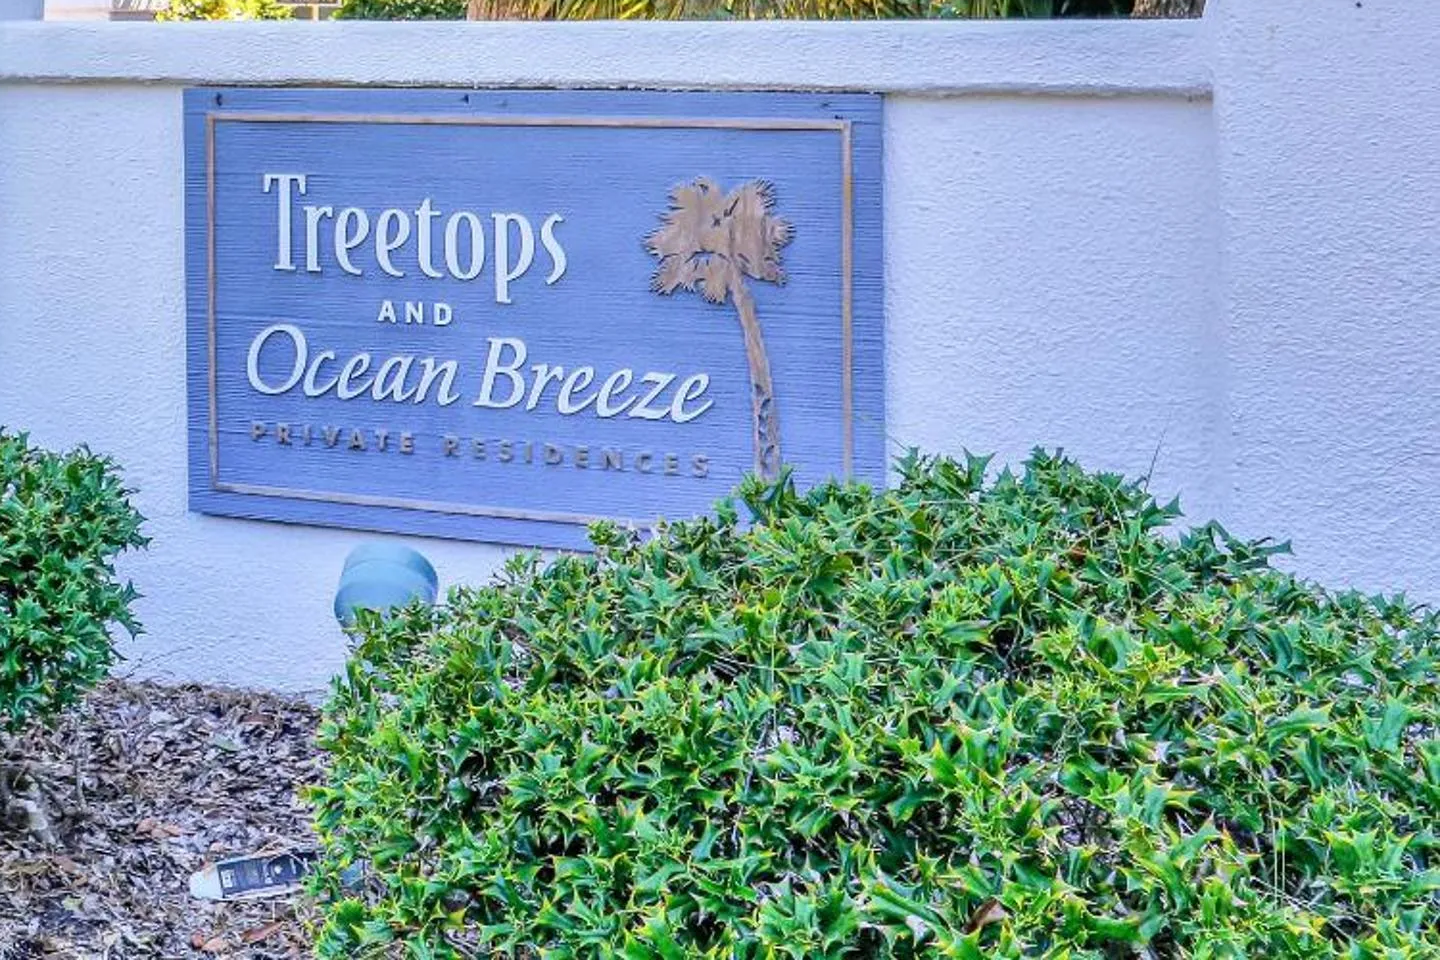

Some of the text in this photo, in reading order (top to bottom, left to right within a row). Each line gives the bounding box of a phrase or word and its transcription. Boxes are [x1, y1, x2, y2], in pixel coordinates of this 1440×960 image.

[263, 173, 568, 304] Treetops
[376, 300, 454, 326] AND
[246, 324, 715, 424] Ocean Breeze
[250, 420, 710, 478] PRIVATE RESIDENCES
